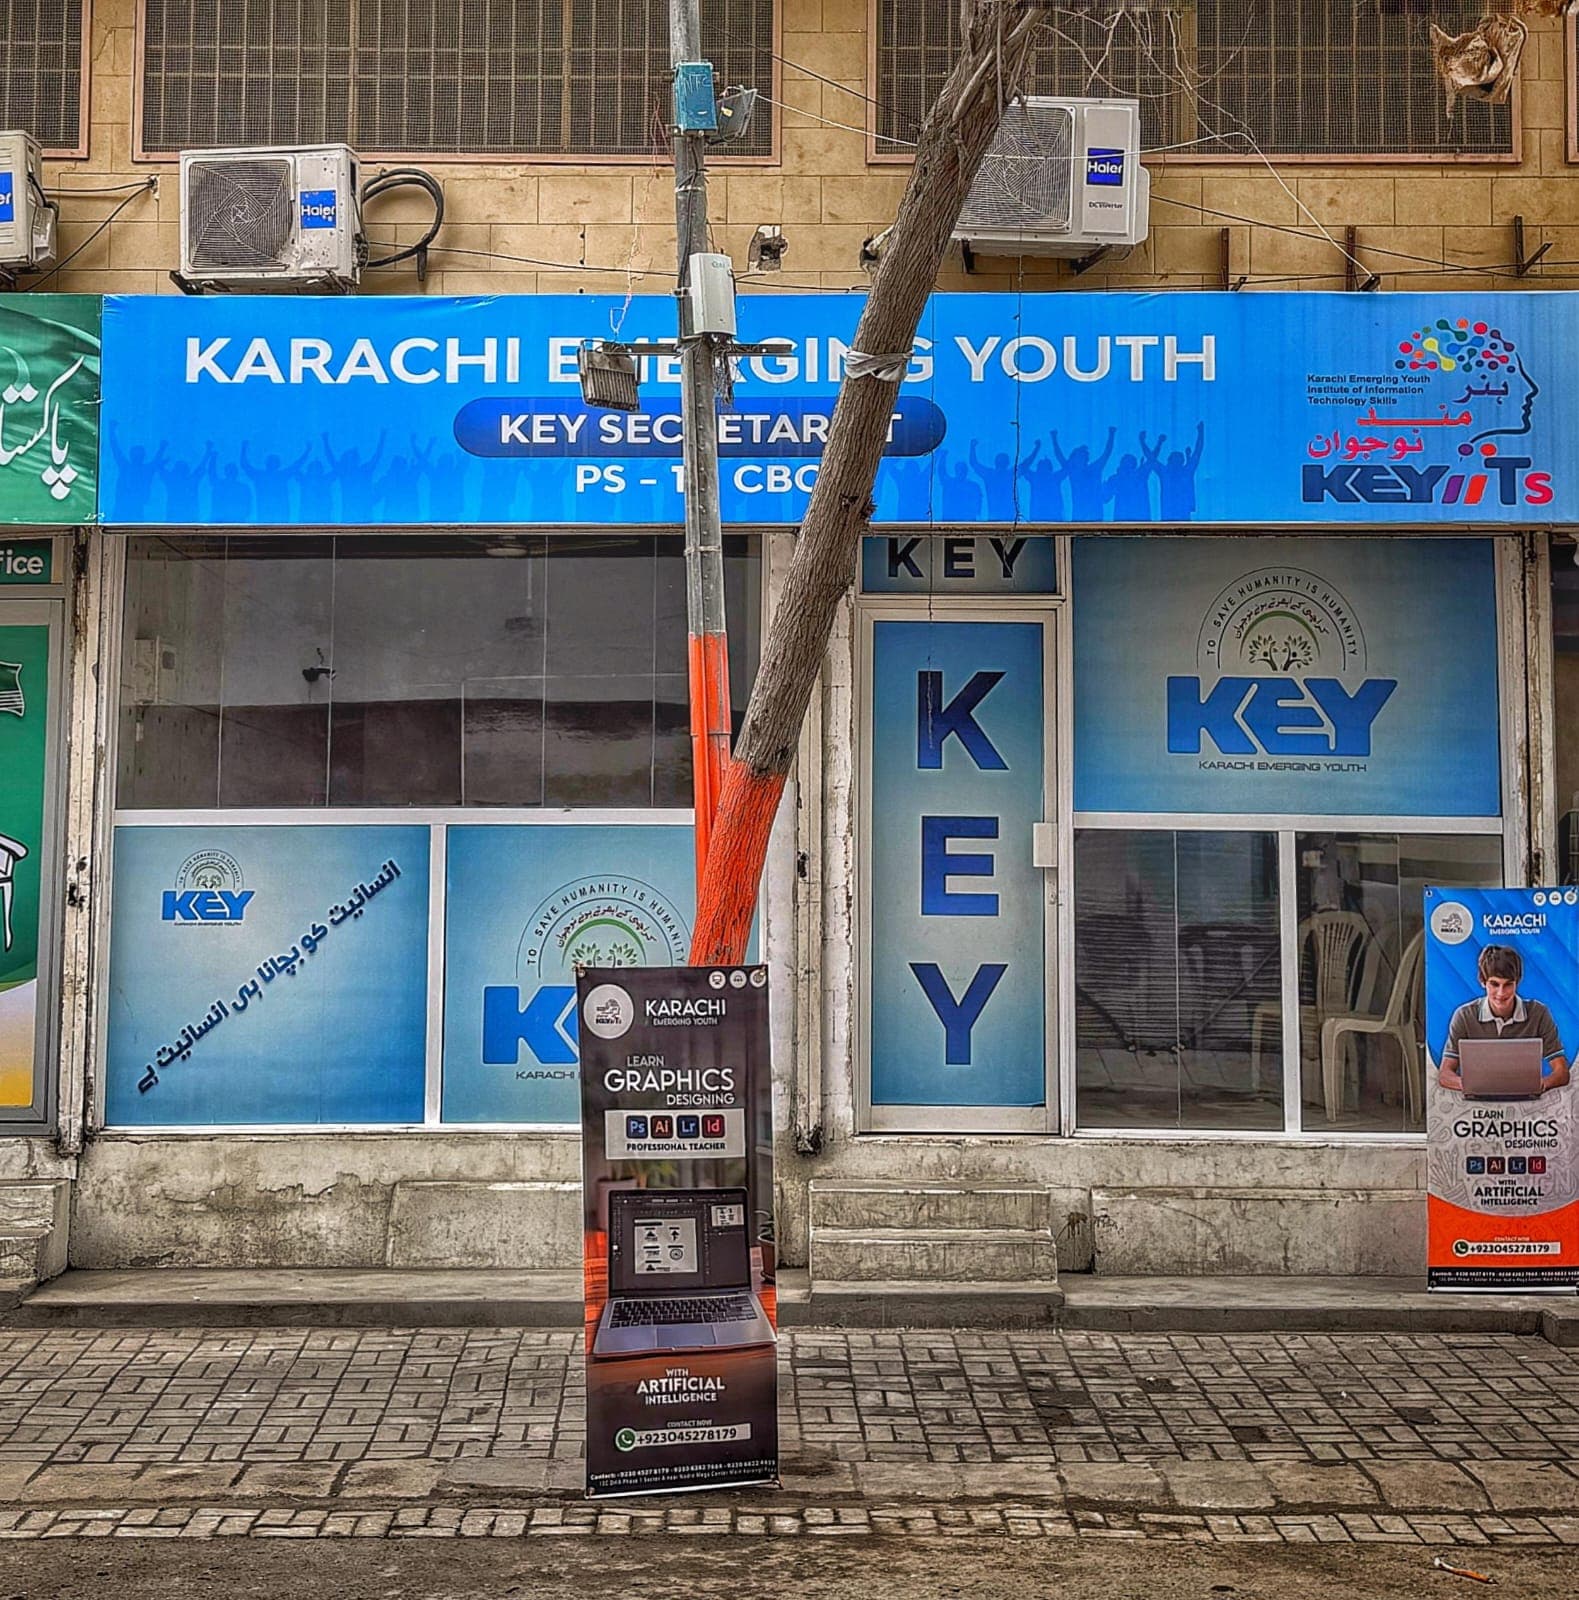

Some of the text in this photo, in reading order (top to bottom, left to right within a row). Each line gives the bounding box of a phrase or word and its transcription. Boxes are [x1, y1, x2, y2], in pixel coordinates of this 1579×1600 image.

[1087, 161, 1123, 174] Haier
[301, 203, 335, 216] Haier
[185, 336, 521, 384] KARACHI
[954, 334, 1217, 383] YOUTH
[1307, 374, 1431, 385] Karachi Emerging Youth
[1307, 385, 1424, 394] Institute of Information
[1308, 395, 1398, 406] Technology Skills
[500, 414, 587, 445] KEY
[1308, 429, 1424, 460] نوجوان
[576, 464, 626, 494] PS
[887, 537, 1029, 578] KEY
[1207, 575, 1358, 656] TO SAVE HUMANITY IS HUMANITY
[1166, 675, 1398, 757] KEY
[1199, 760, 1367, 773] KARACHI EMERGING YOUTH
[329, 859, 402, 926] انسانیت
[162, 890, 255, 921] KEY
[527, 883, 687, 966] TO SAVE HUMANITY IS HUMANITY
[1483, 912, 1547, 928] KARACHI
[301, 923, 328, 954] کو
[257, 946, 305, 983] بچانا
[645, 998, 727, 1017] KARACHI
[653, 1016, 718, 1026] EMERGING YOUTH
[156, 1000, 229, 1067] انسانیت
[627, 1055, 665, 1067] LEARN
[515, 1071, 574, 1080] KARACHI
[604, 1067, 735, 1092] GRAPHICS
[666, 1092, 735, 1105] DESIGNING
[1472, 1109, 1504, 1120] LEARN
[630, 1119, 720, 1133] Ps Ai Lr Id
[1453, 1120, 1558, 1139] GRAPHICS
[626, 1141, 726, 1151] PROFESSIONAL TEACHER
[1504, 1138, 1558, 1149] DESIGNING
[1470, 1159, 1482, 1170] Ps
[1512, 1159, 1524, 1170] Lr
[1532, 1158, 1542, 1170] Id
[1474, 1186, 1545, 1198] ARTIFICIAL
[1480, 1198, 1538, 1206] INTELLIGENCE
[1470, 1244, 1550, 1253] +923045278179
[665, 1367, 689, 1377] WITH
[636, 1376, 726, 1395] ARTIFICIAL
[645, 1392, 717, 1405] INTELLIGENCE
[637, 1427, 737, 1445] +923045278179
